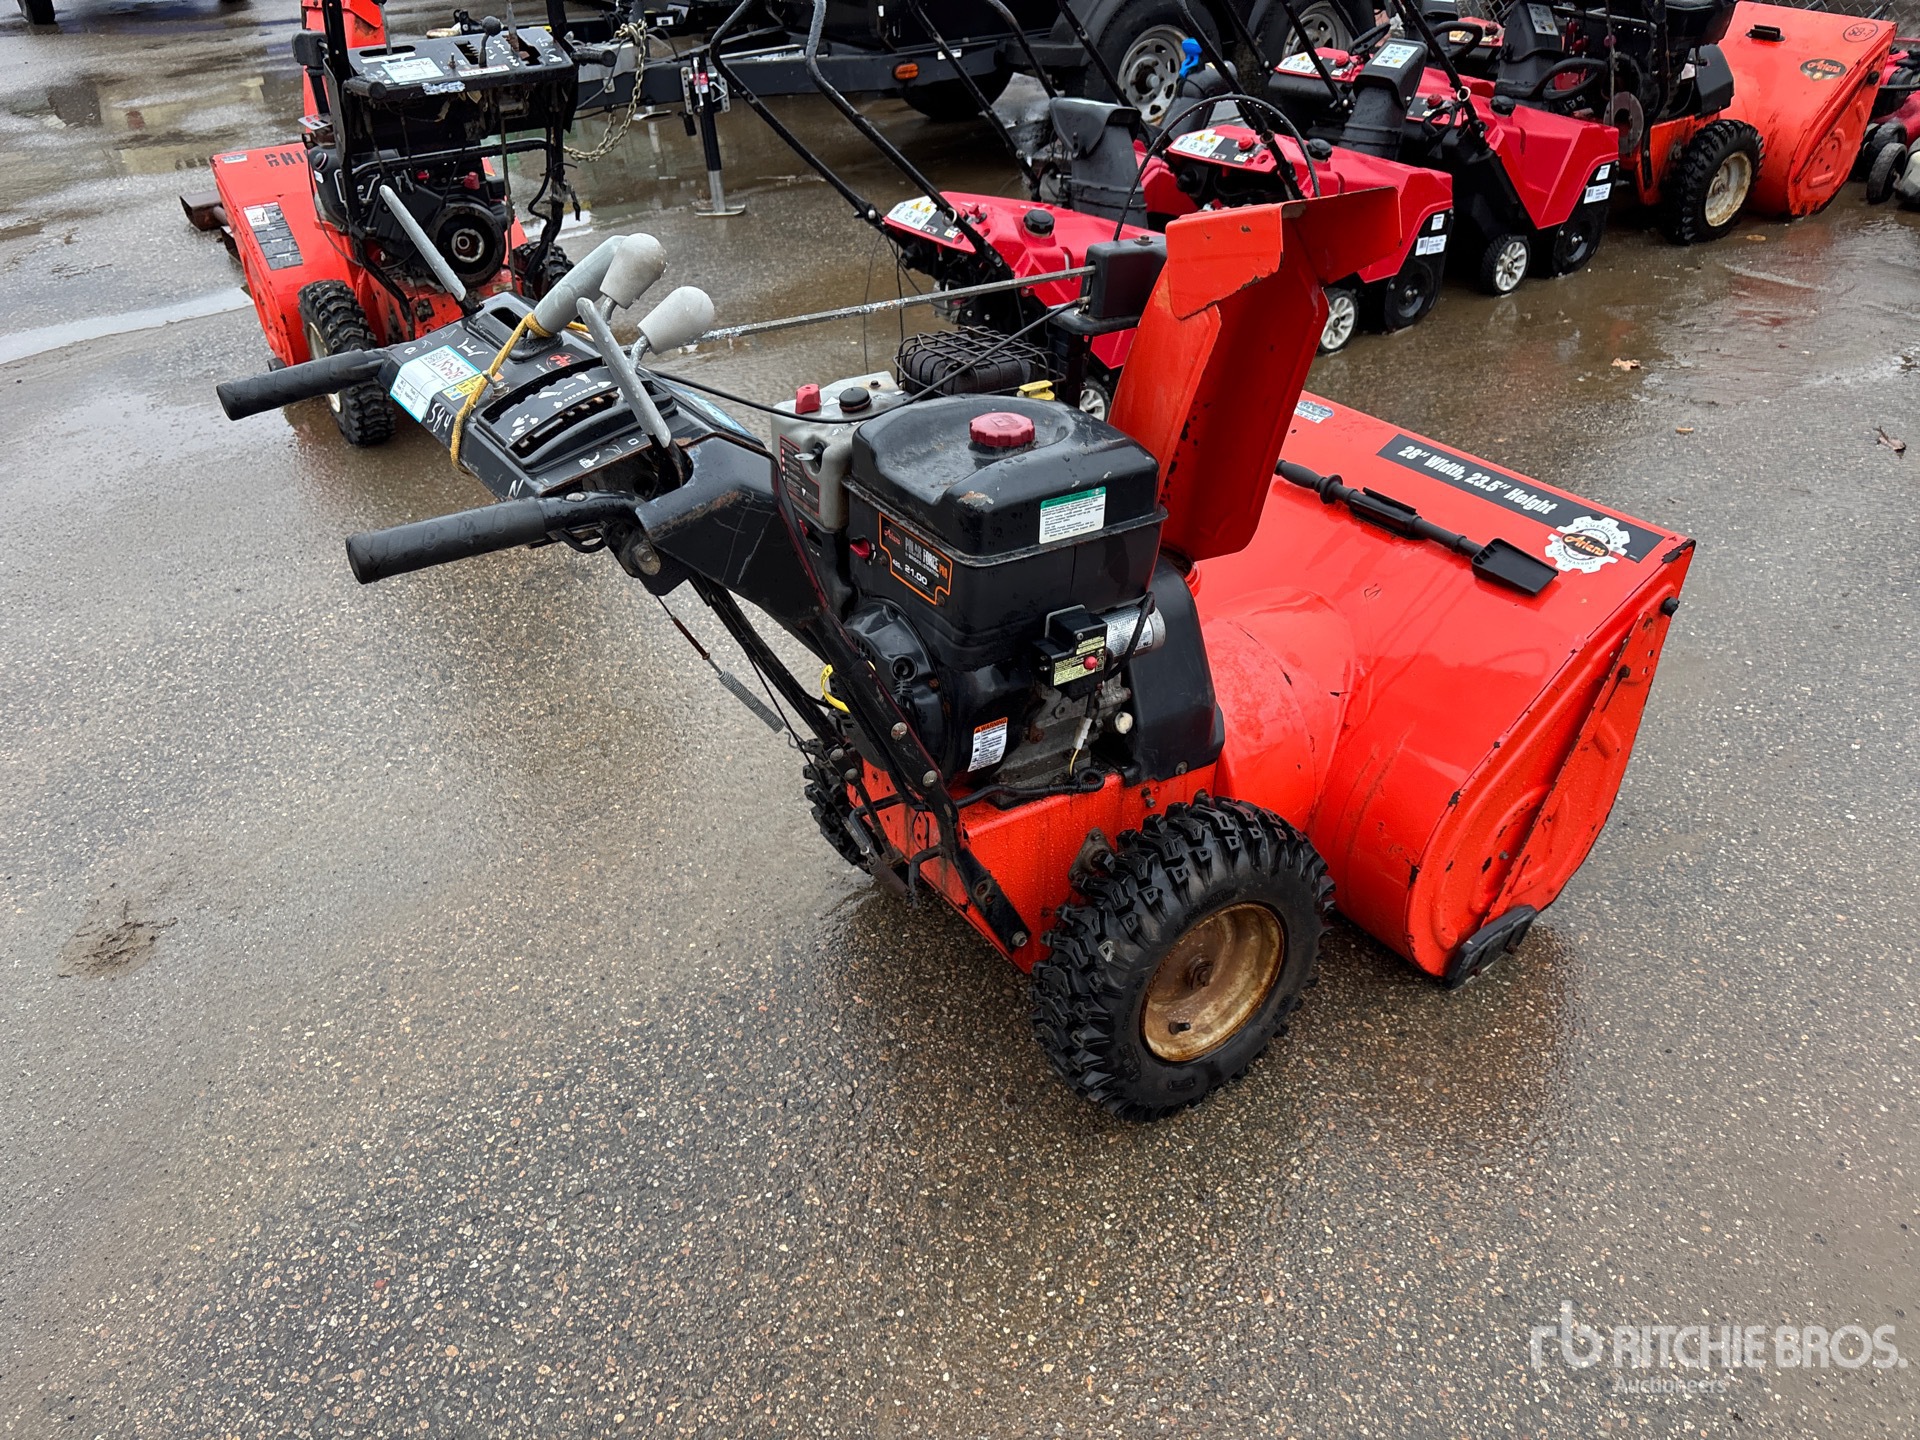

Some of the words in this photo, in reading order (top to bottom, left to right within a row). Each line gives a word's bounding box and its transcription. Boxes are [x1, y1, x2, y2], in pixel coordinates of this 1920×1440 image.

[1806, 60, 1842, 74] Ariens
[1397, 445, 1431, 460] 28"
[1424, 455, 1466, 481] Width,
[1464, 472, 1512, 492] 23.5"
[1503, 488, 1558, 515] Height
[1564, 535, 1606, 556] Ariens
[904, 564, 928, 585] 21.00
[981, 718, 1007, 731] WARNING
